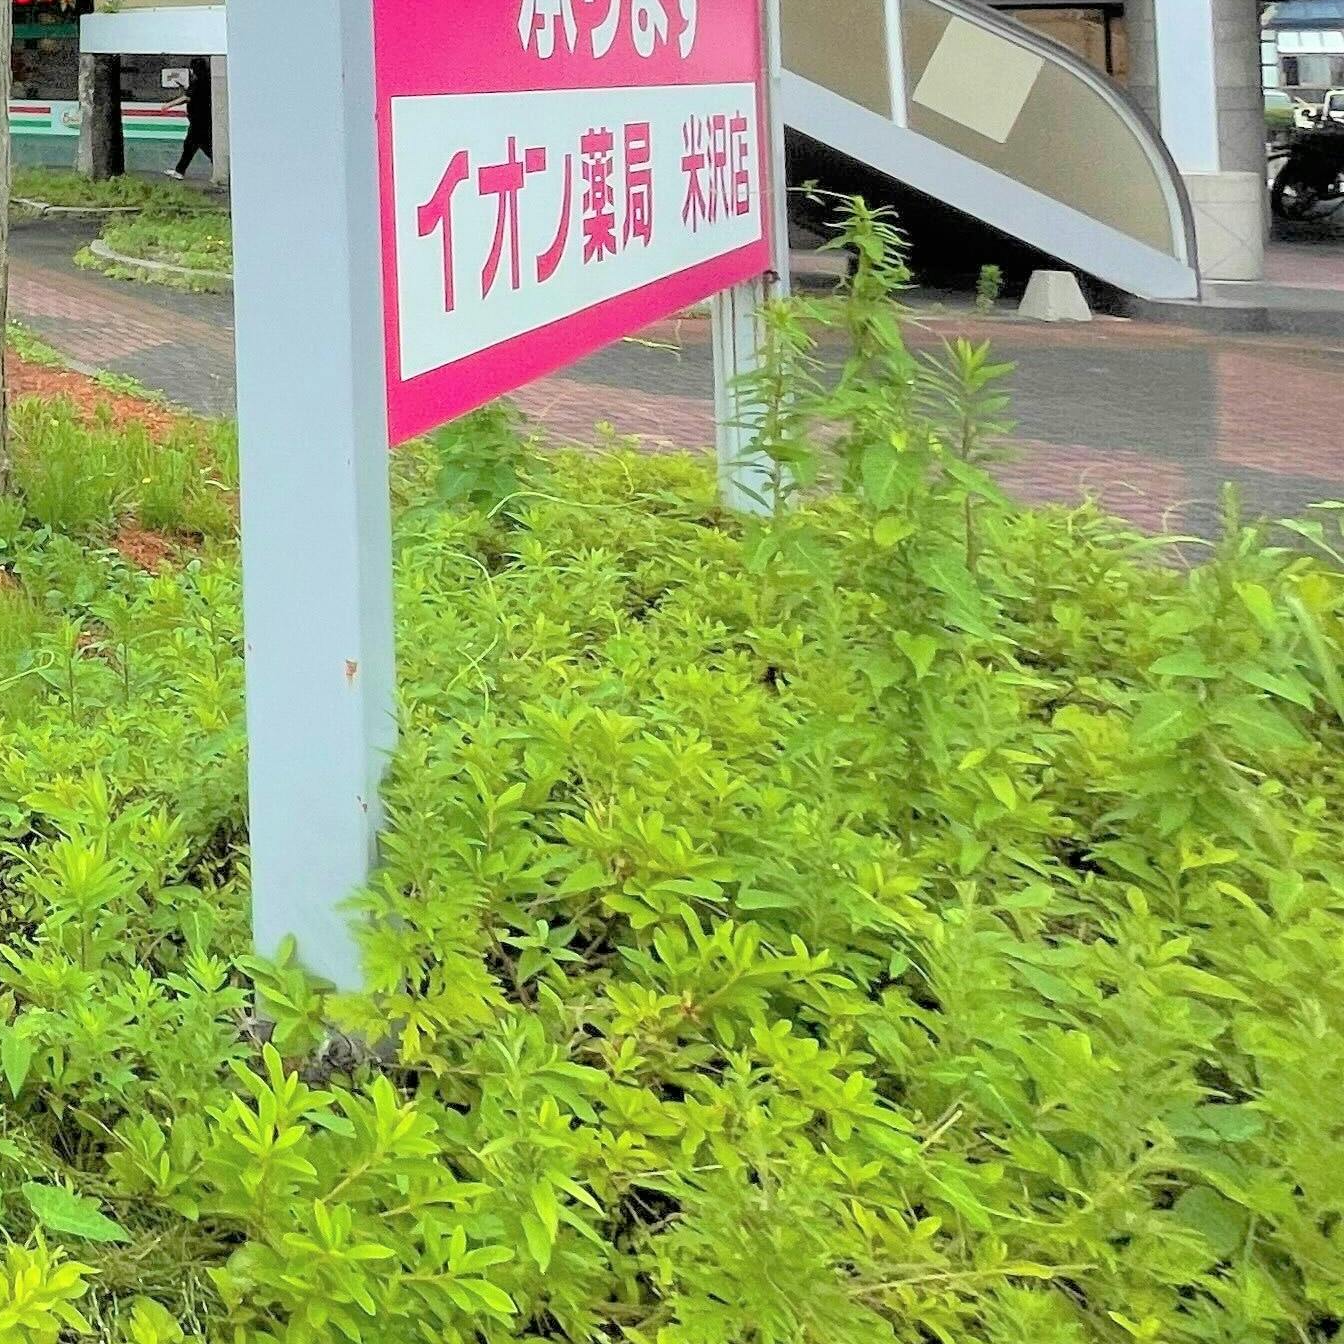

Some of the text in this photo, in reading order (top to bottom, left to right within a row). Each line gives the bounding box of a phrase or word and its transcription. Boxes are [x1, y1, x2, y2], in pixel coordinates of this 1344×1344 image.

[417, 114, 753, 313] イオン薬局 米沢店
